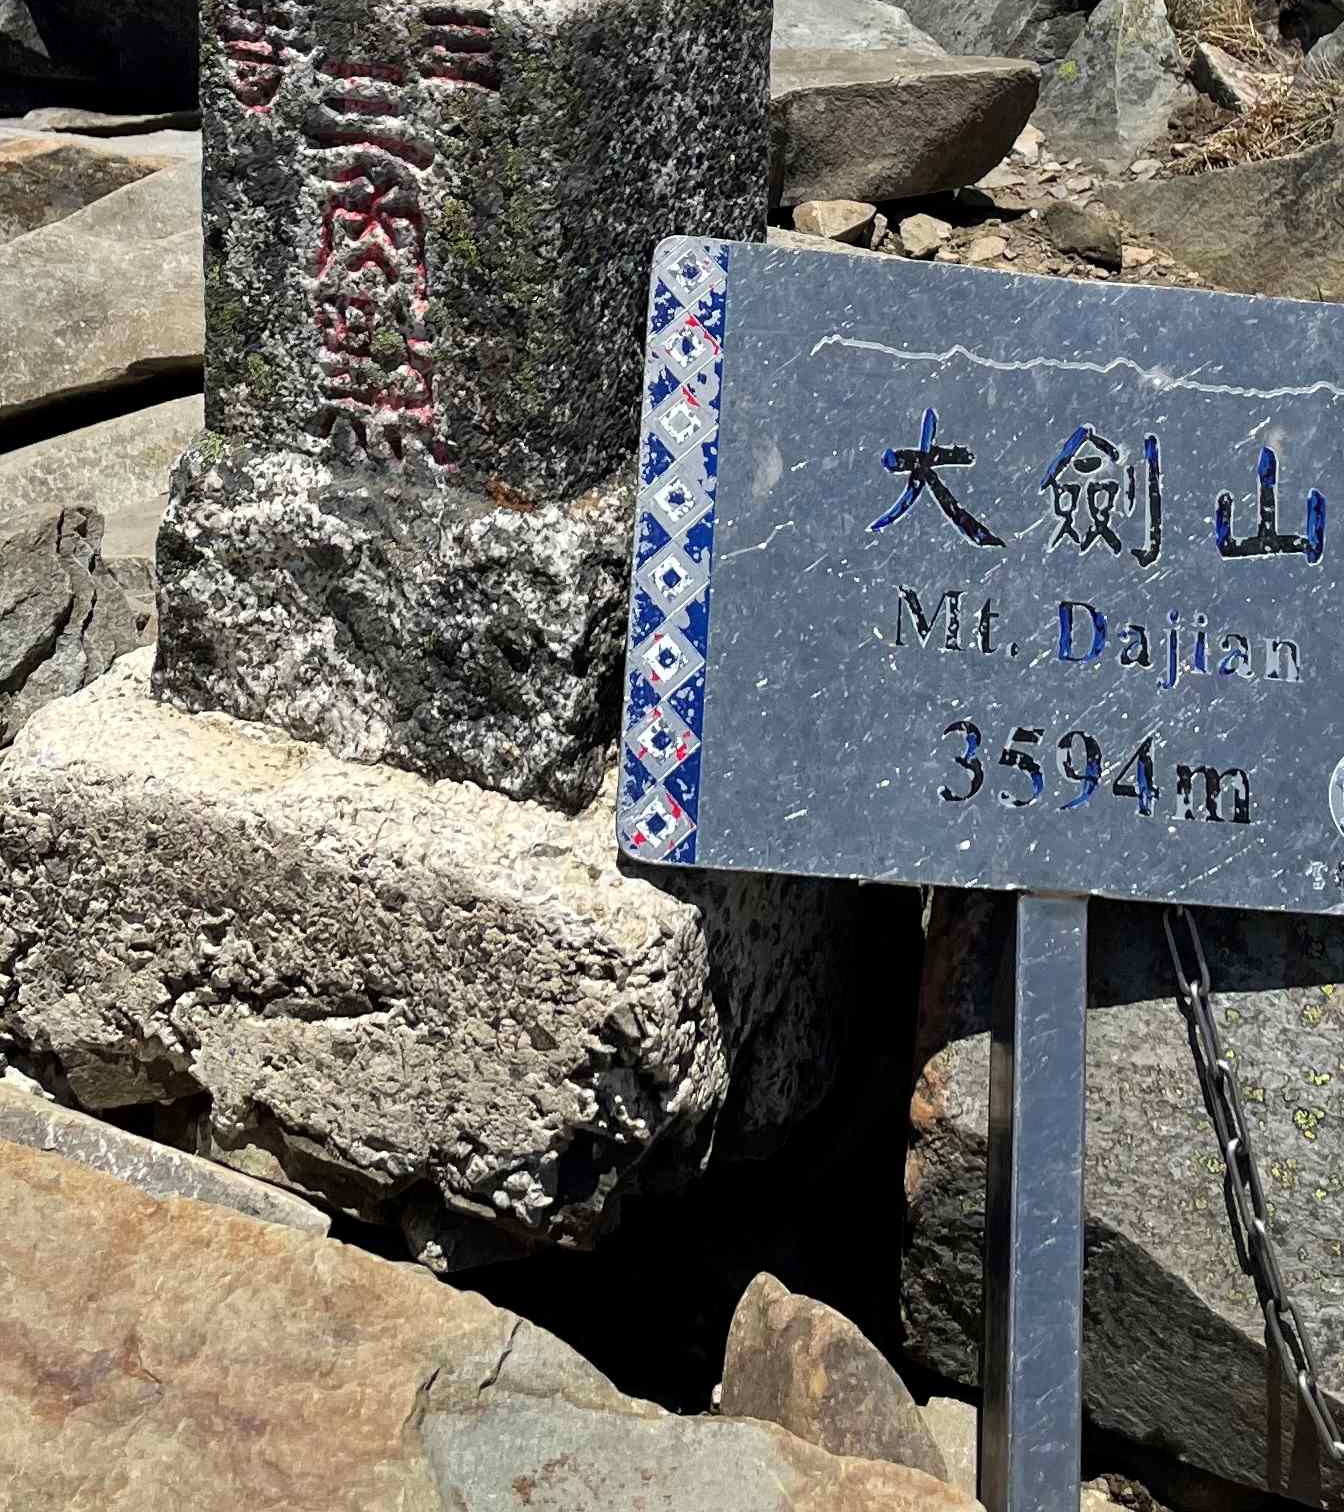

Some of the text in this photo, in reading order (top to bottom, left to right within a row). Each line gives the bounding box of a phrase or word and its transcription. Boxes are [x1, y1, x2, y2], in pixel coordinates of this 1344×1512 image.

[864, 406, 1328, 568] 大劍山
[891, 583, 1305, 690] Mt. Dajian
[936, 718, 1254, 826] 3594m
